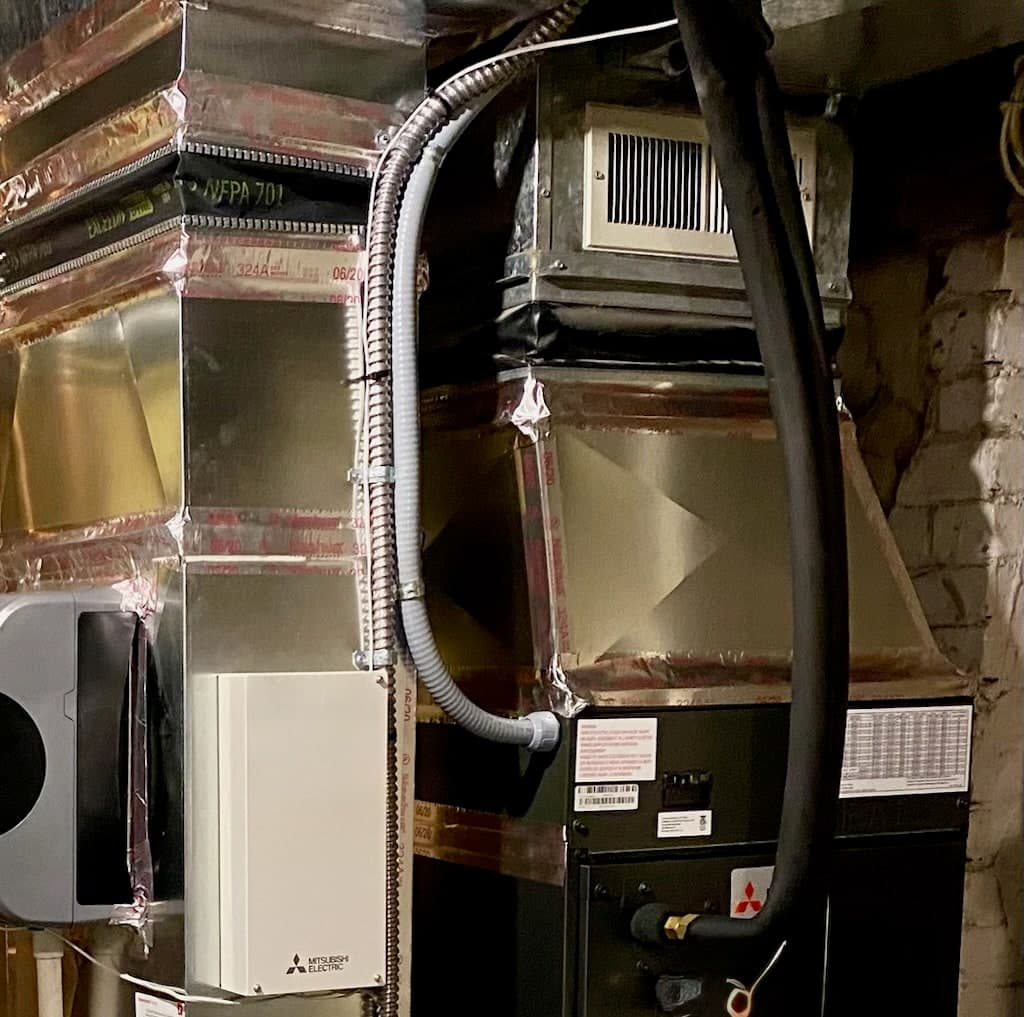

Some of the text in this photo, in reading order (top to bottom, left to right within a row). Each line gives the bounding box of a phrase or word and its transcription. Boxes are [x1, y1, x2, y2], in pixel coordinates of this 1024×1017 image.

[203, 178, 284, 207] NFPA 701
[332, 265, 364, 281] 06/20
[308, 963, 345, 973] ELECTRIC
